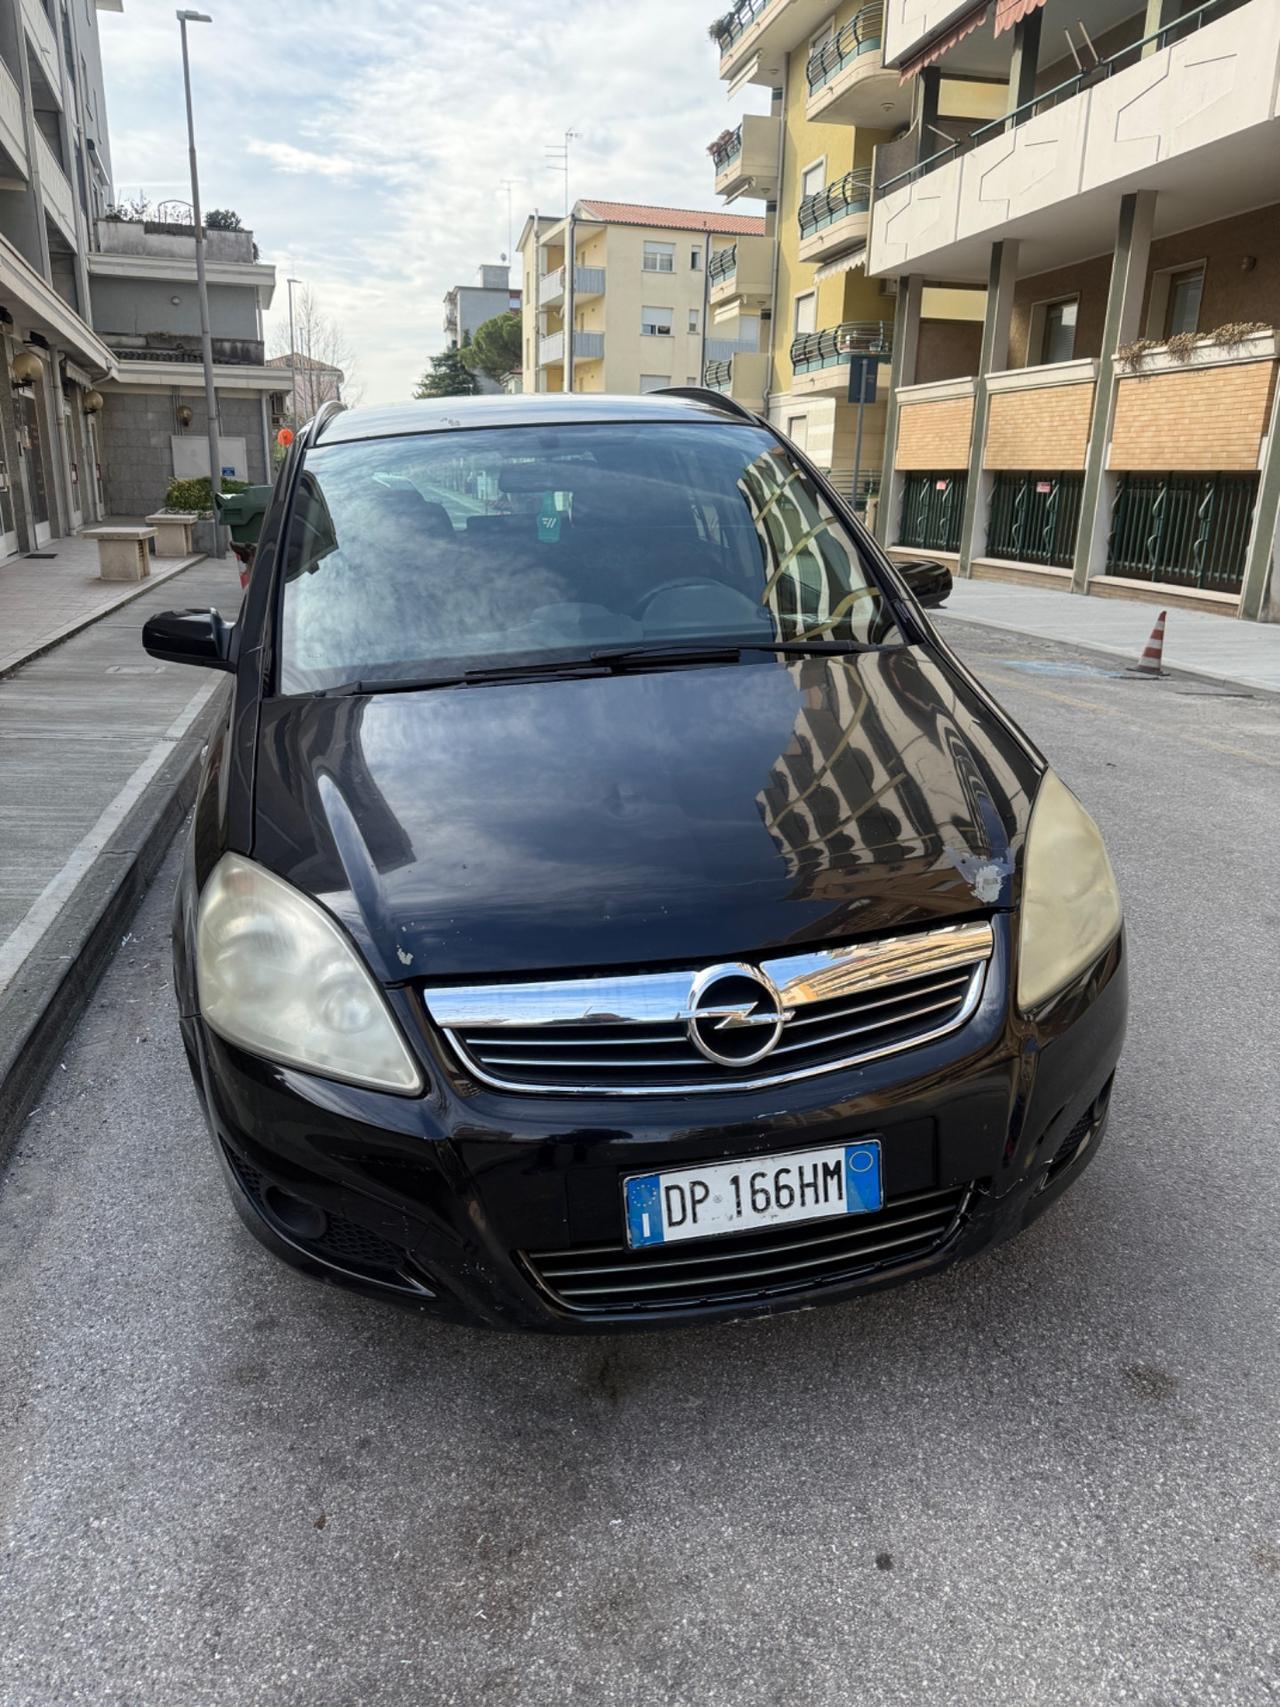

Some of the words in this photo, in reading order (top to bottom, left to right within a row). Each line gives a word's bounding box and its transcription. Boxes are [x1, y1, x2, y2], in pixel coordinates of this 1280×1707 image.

[664, 1180, 710, 1228] DP
[729, 1158, 844, 1218] 166HM
[641, 1213, 651, 1238] I
